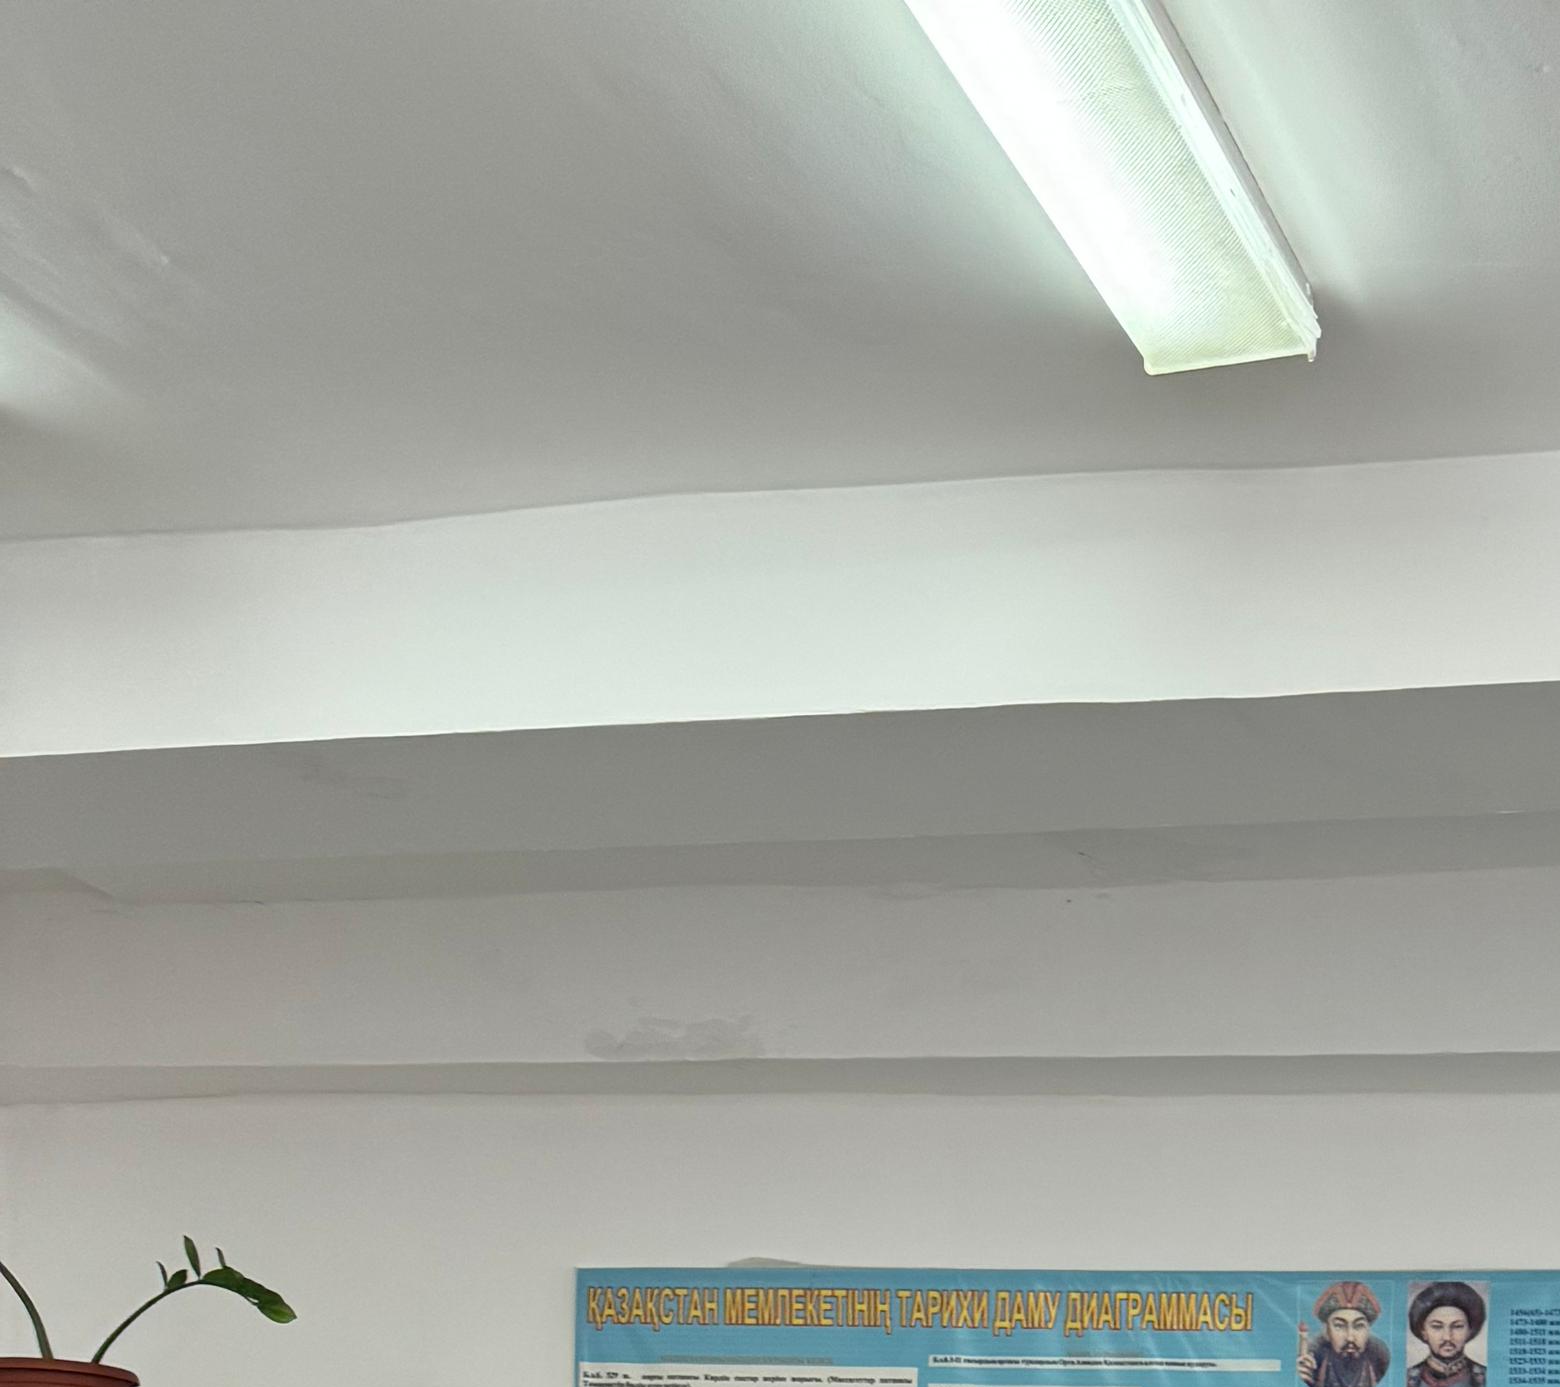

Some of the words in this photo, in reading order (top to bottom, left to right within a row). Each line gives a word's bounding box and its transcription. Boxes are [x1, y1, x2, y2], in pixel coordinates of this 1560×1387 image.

[587, 1286, 719, 1332] ҚАЗАҚСТАН
[724, 1287, 892, 1335] МЕМЛЕКЕТІНІҢ
[896, 1289, 988, 1329] ТАРИХИ
[993, 1290, 1060, 1337] ДАМУ
[1064, 1291, 1254, 1338] ДИАГРАММАСЫ
